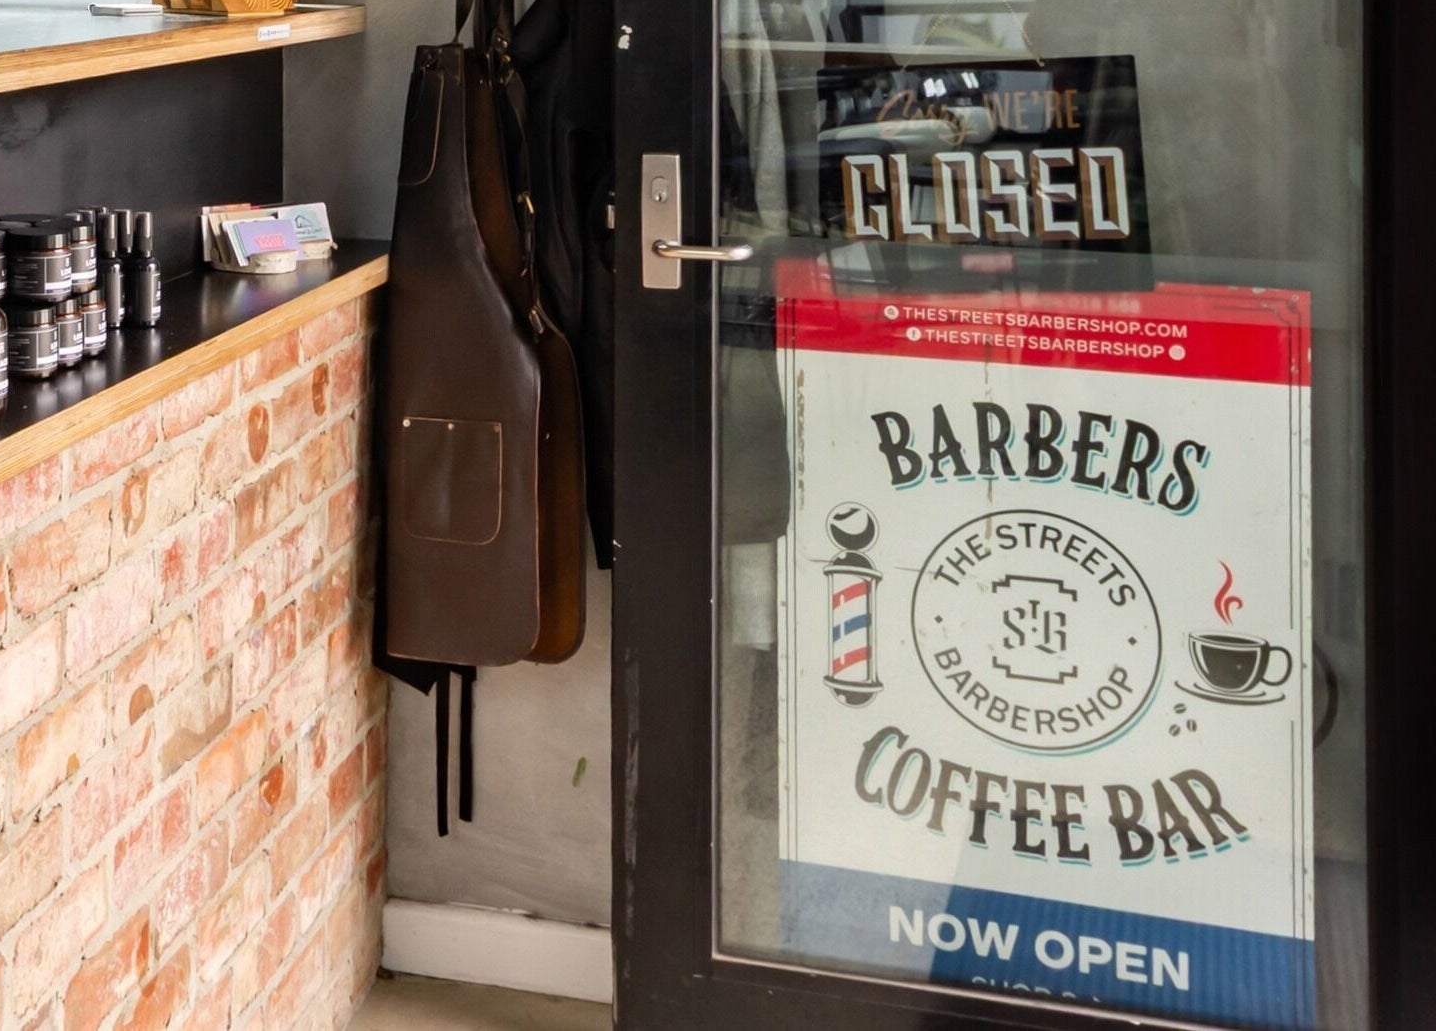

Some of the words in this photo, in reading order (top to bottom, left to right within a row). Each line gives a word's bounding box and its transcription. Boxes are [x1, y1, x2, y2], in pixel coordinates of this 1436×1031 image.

[842, 146, 1131, 243] CLOSED
[902, 305, 1189, 340] THESTREETSBARBERSHOP.COM
[924, 327, 1166, 360] THESTREETSBARBERSHOP
[871, 402, 1211, 516] BARBERS
[933, 533, 993, 590] THE
[995, 521, 1138, 608] STREETS
[933, 646, 1131, 736] BARBERSHOP
[854, 725, 1092, 864] COFFEE
[1102, 767, 1251, 867] BAR
[889, 906, 1020, 962] NOW
[1034, 930, 1190, 992] OPEN
